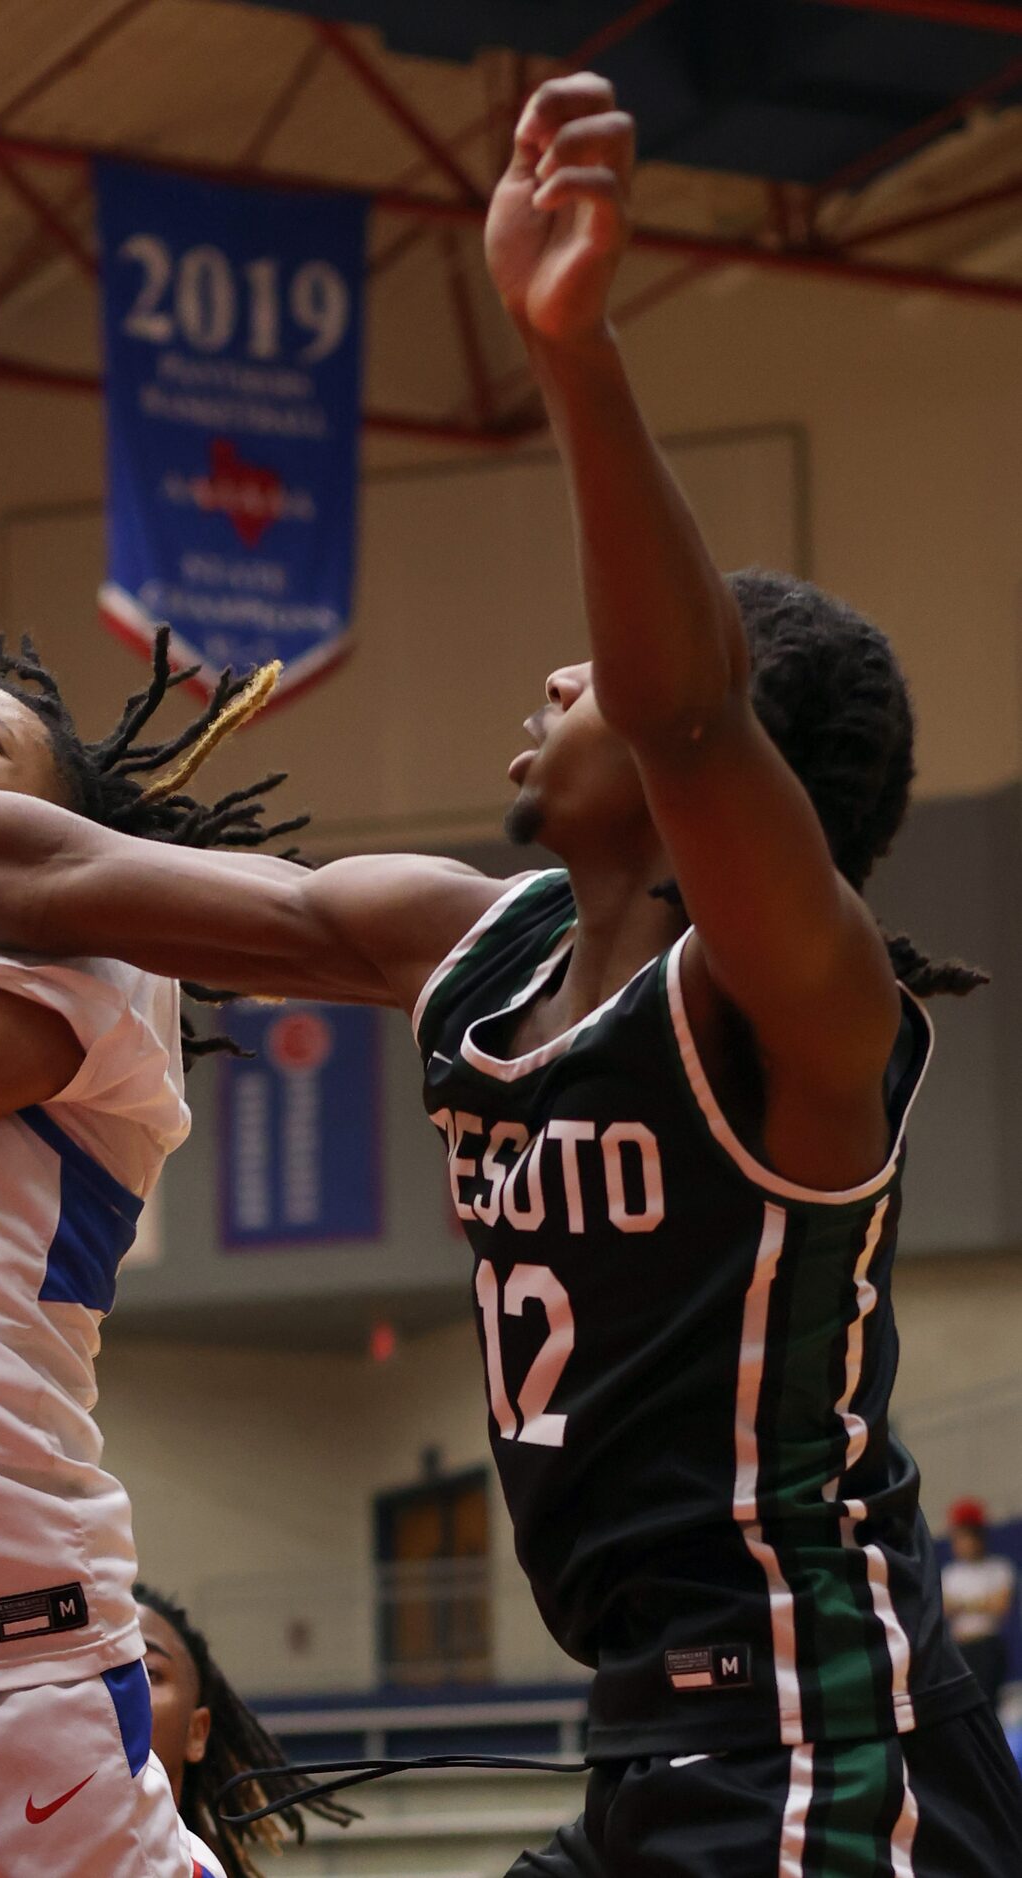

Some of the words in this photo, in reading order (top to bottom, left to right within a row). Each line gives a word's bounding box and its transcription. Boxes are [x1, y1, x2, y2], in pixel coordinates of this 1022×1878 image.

[119, 233, 349, 364] 2019
[475, 1258, 576, 1447] 12
[59, 1599, 76, 1618] M
[721, 1656, 739, 1676] M
